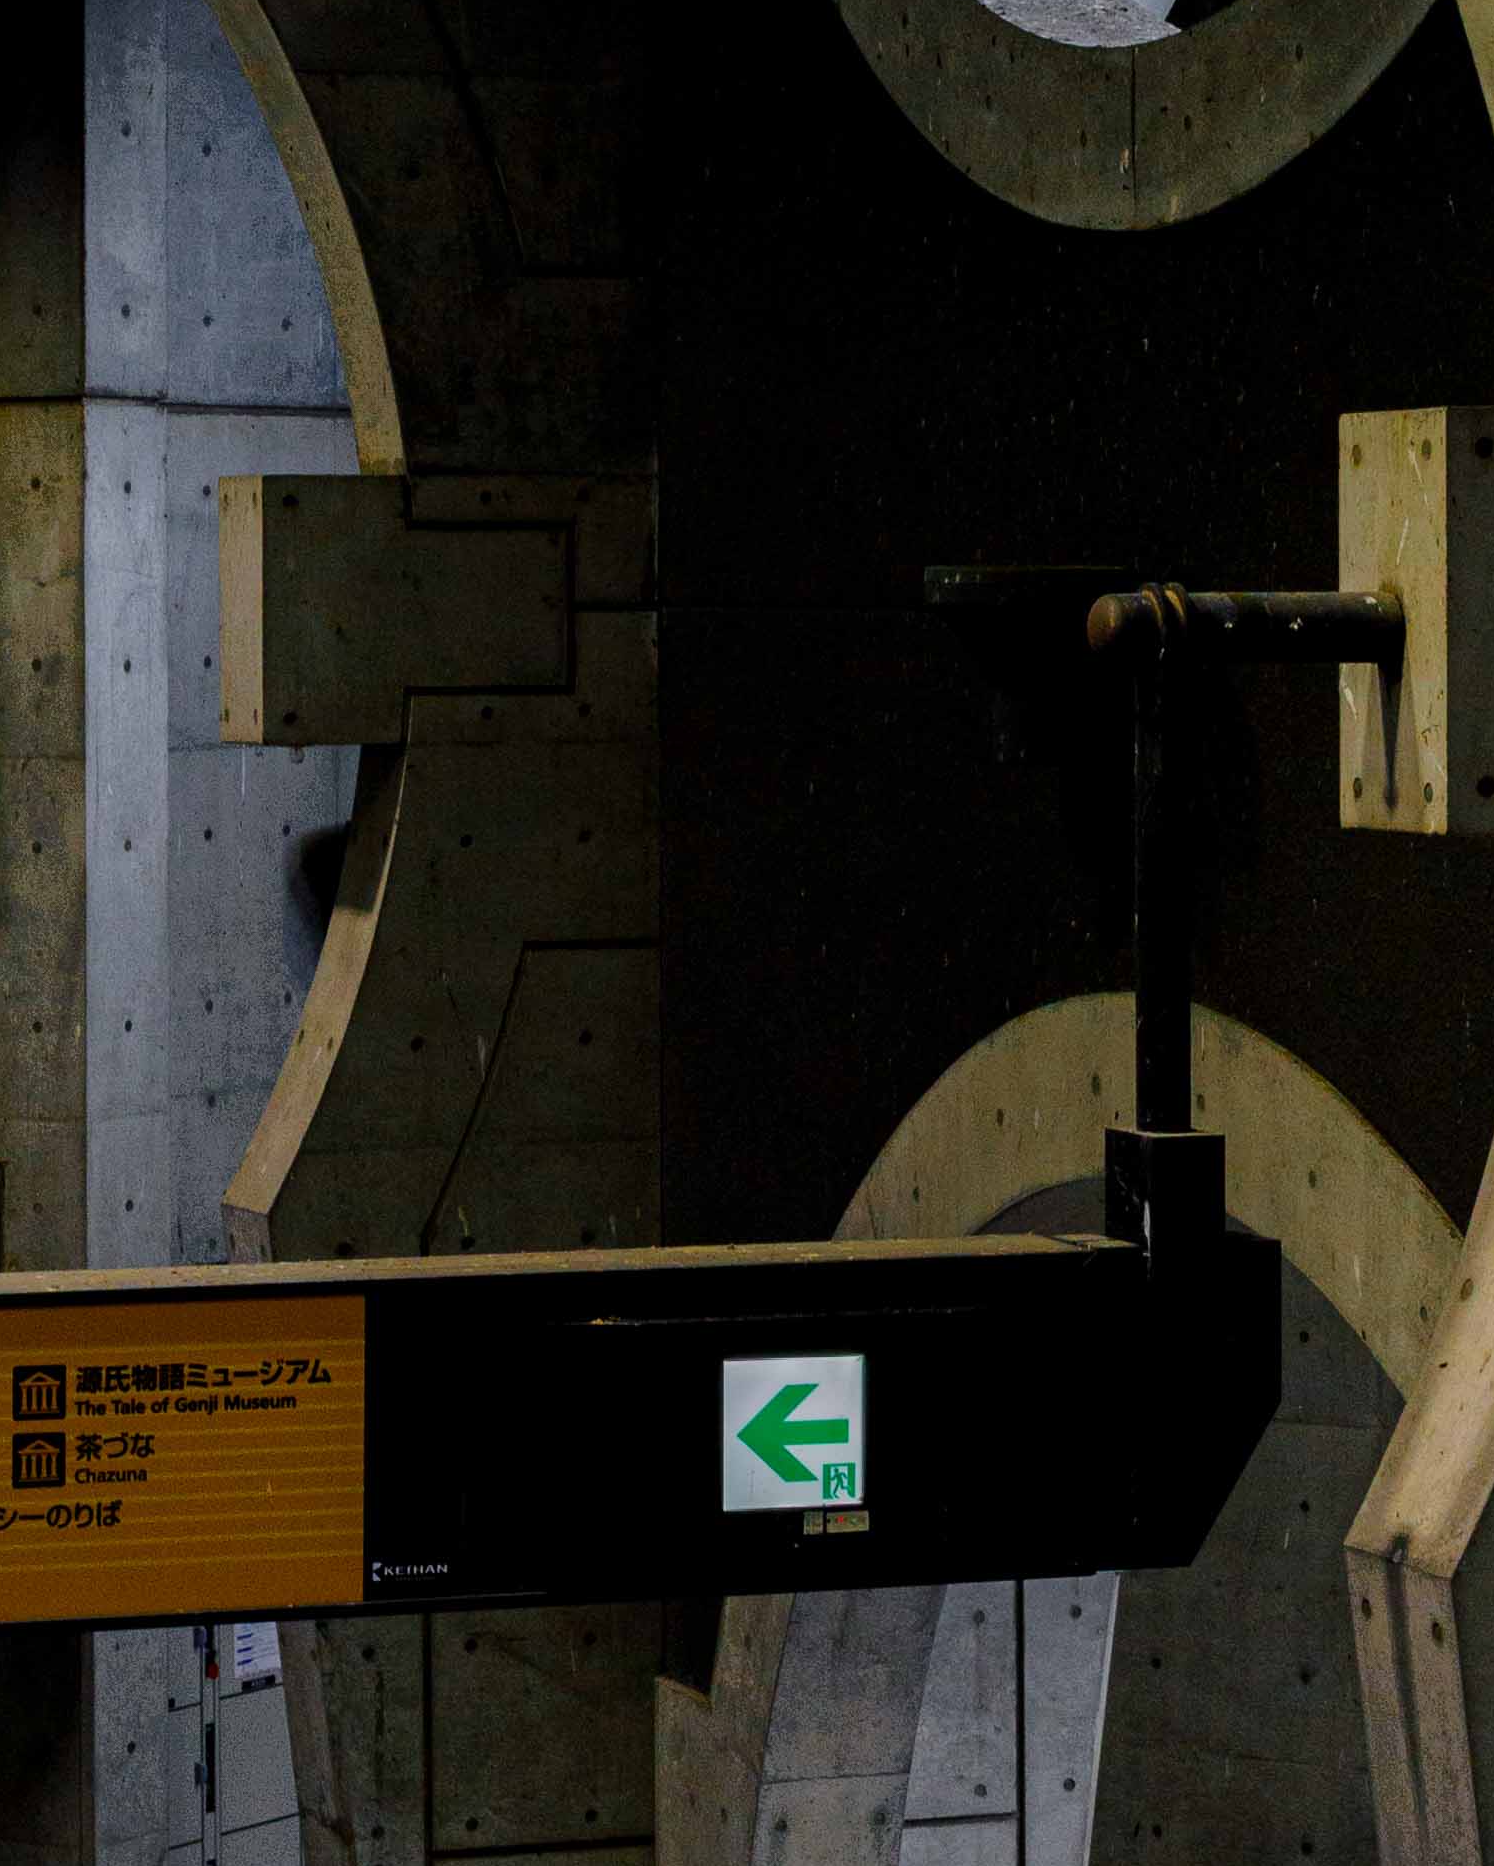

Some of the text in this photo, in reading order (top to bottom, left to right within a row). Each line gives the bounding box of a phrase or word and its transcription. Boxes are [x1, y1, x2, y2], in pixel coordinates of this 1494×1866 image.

[75, 1359, 332, 1394] 源氏物語ミュージアム
[75, 1394, 297, 1416] The Tale of Genji Museum
[75, 1433, 155, 1461] 茶づな
[75, 1467, 148, 1484] Chazuna
